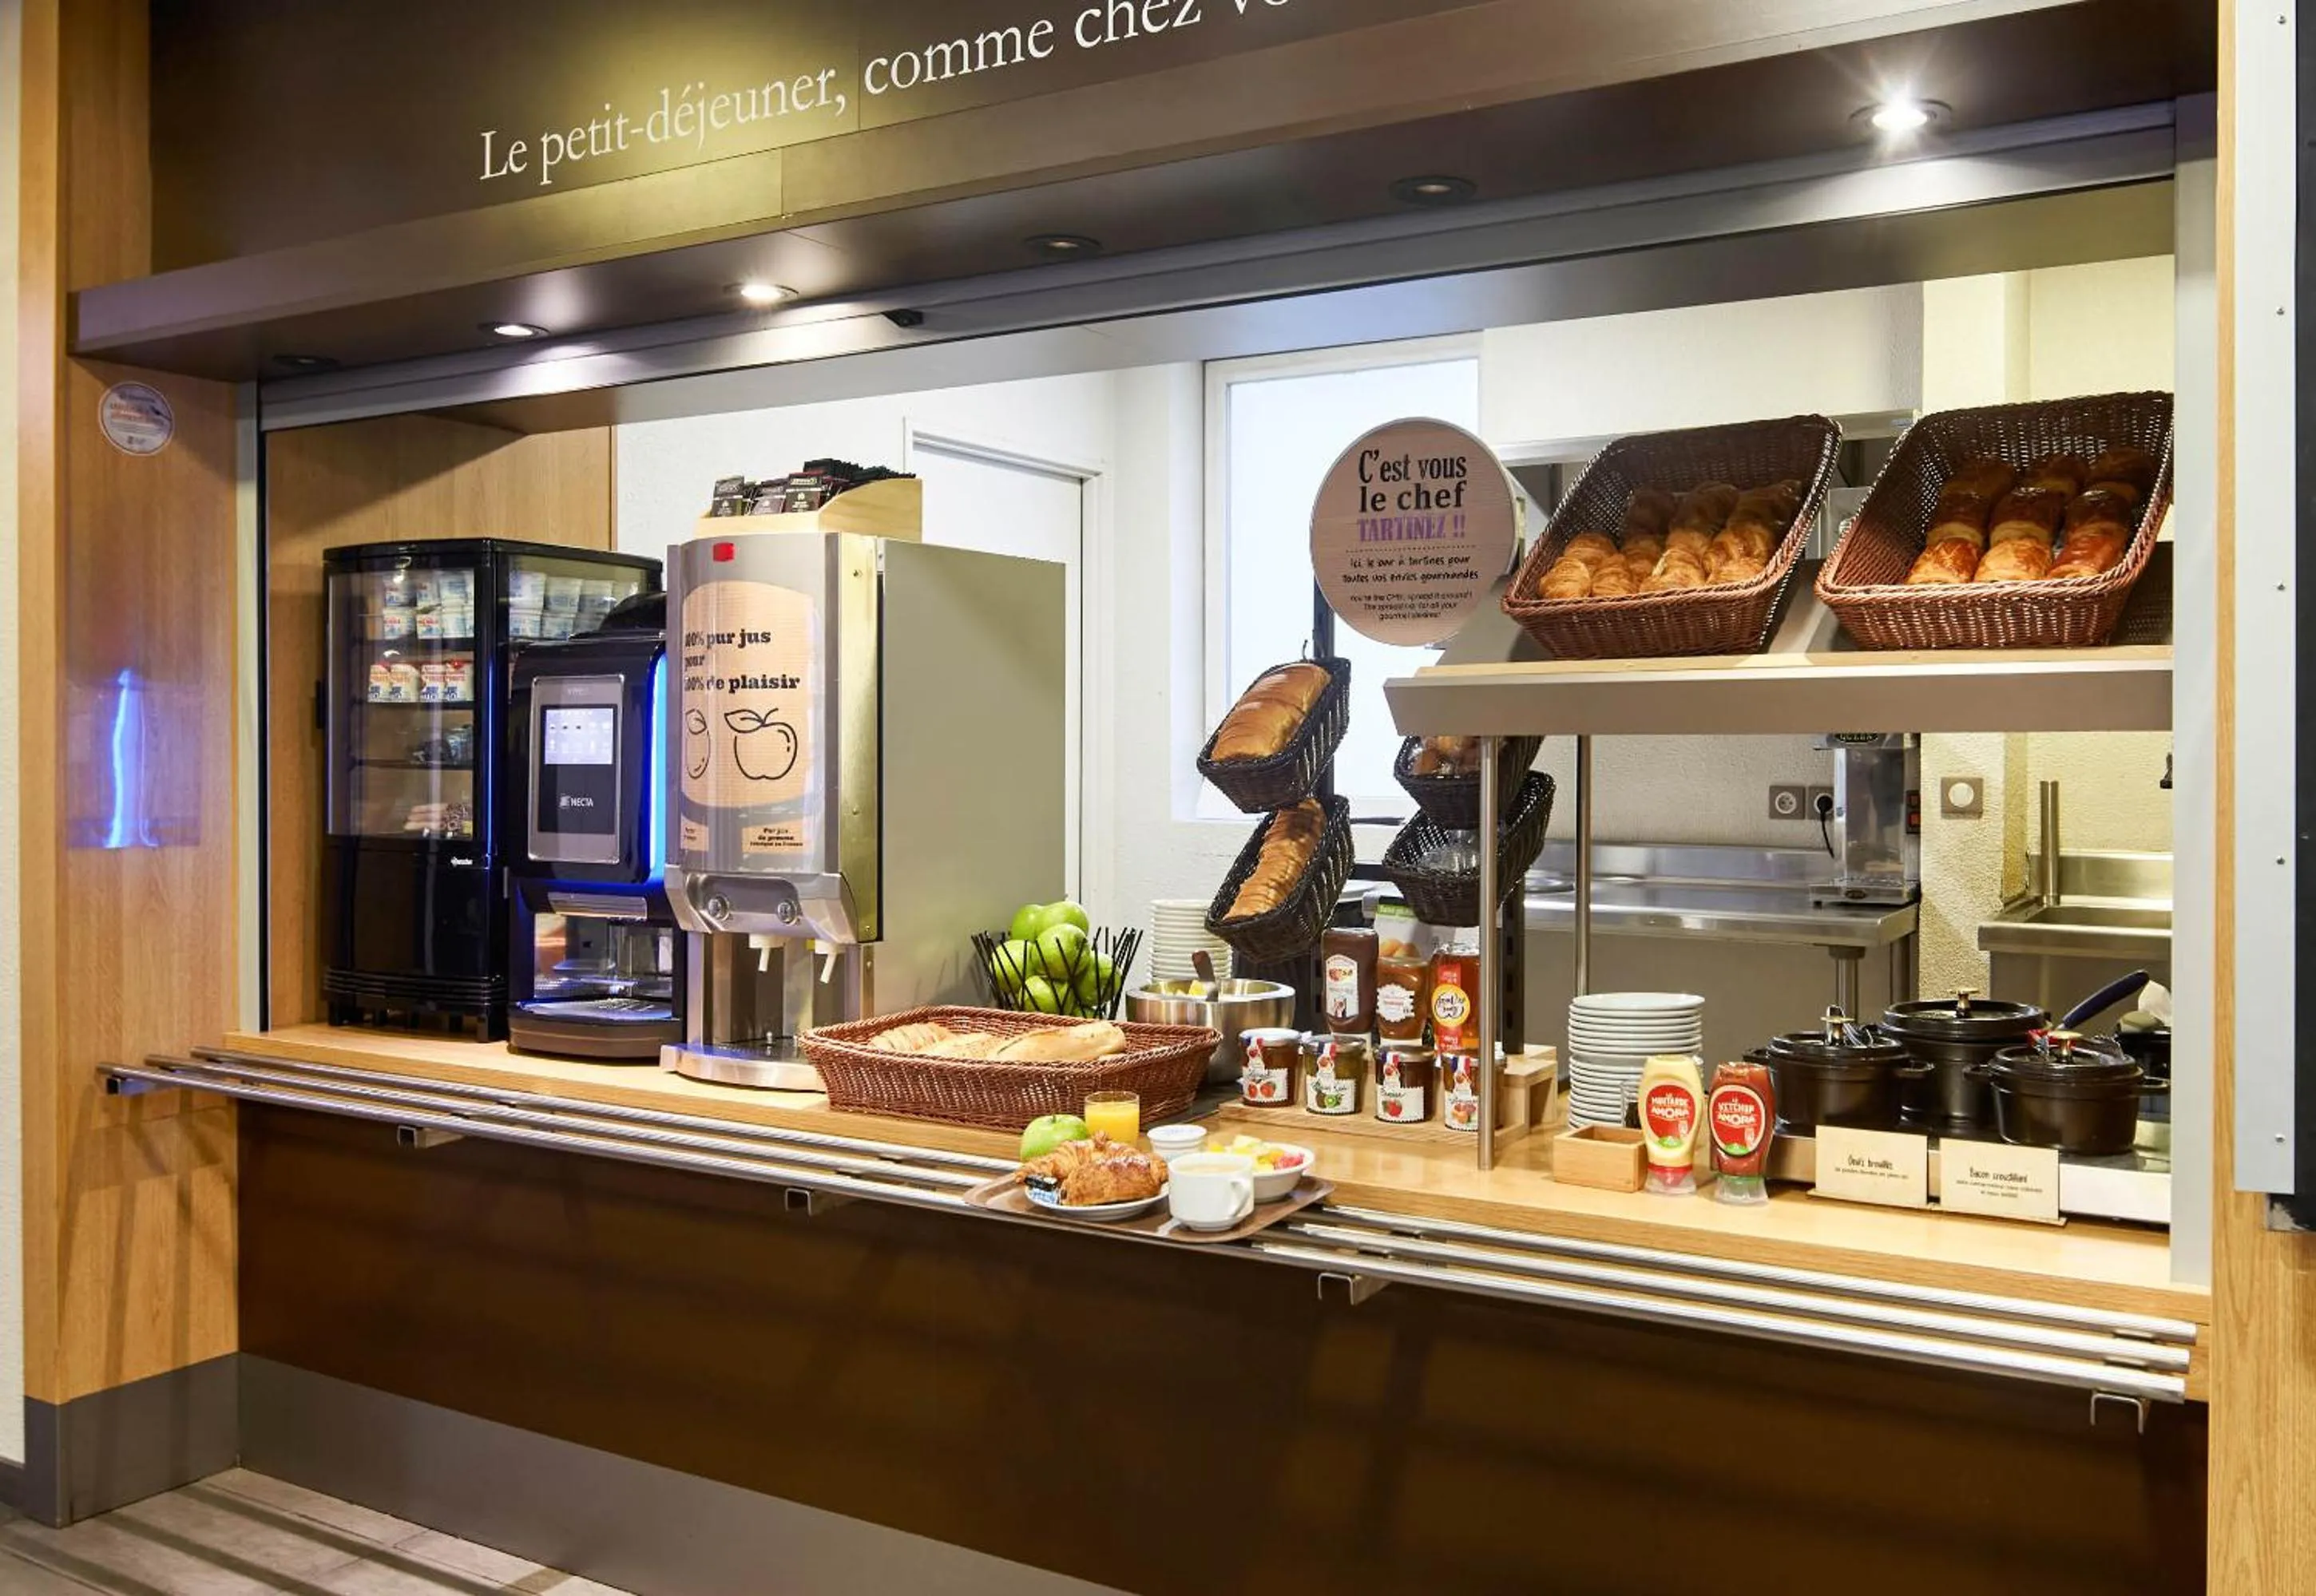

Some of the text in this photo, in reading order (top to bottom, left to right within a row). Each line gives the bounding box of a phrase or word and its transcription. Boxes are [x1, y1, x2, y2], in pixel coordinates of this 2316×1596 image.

[480, 0, 1201, 185] Le petit-déjeuner, comme chez
[1358, 449, 1467, 483] C'est vous
[1359, 480, 1467, 513] le chef
[1358, 515, 1446, 542] TARTINEZ
[1448, 556, 1471, 568] pour
[706, 632, 736, 649] pur
[738, 628, 771, 648] jus
[728, 674, 801, 694] plaisir
